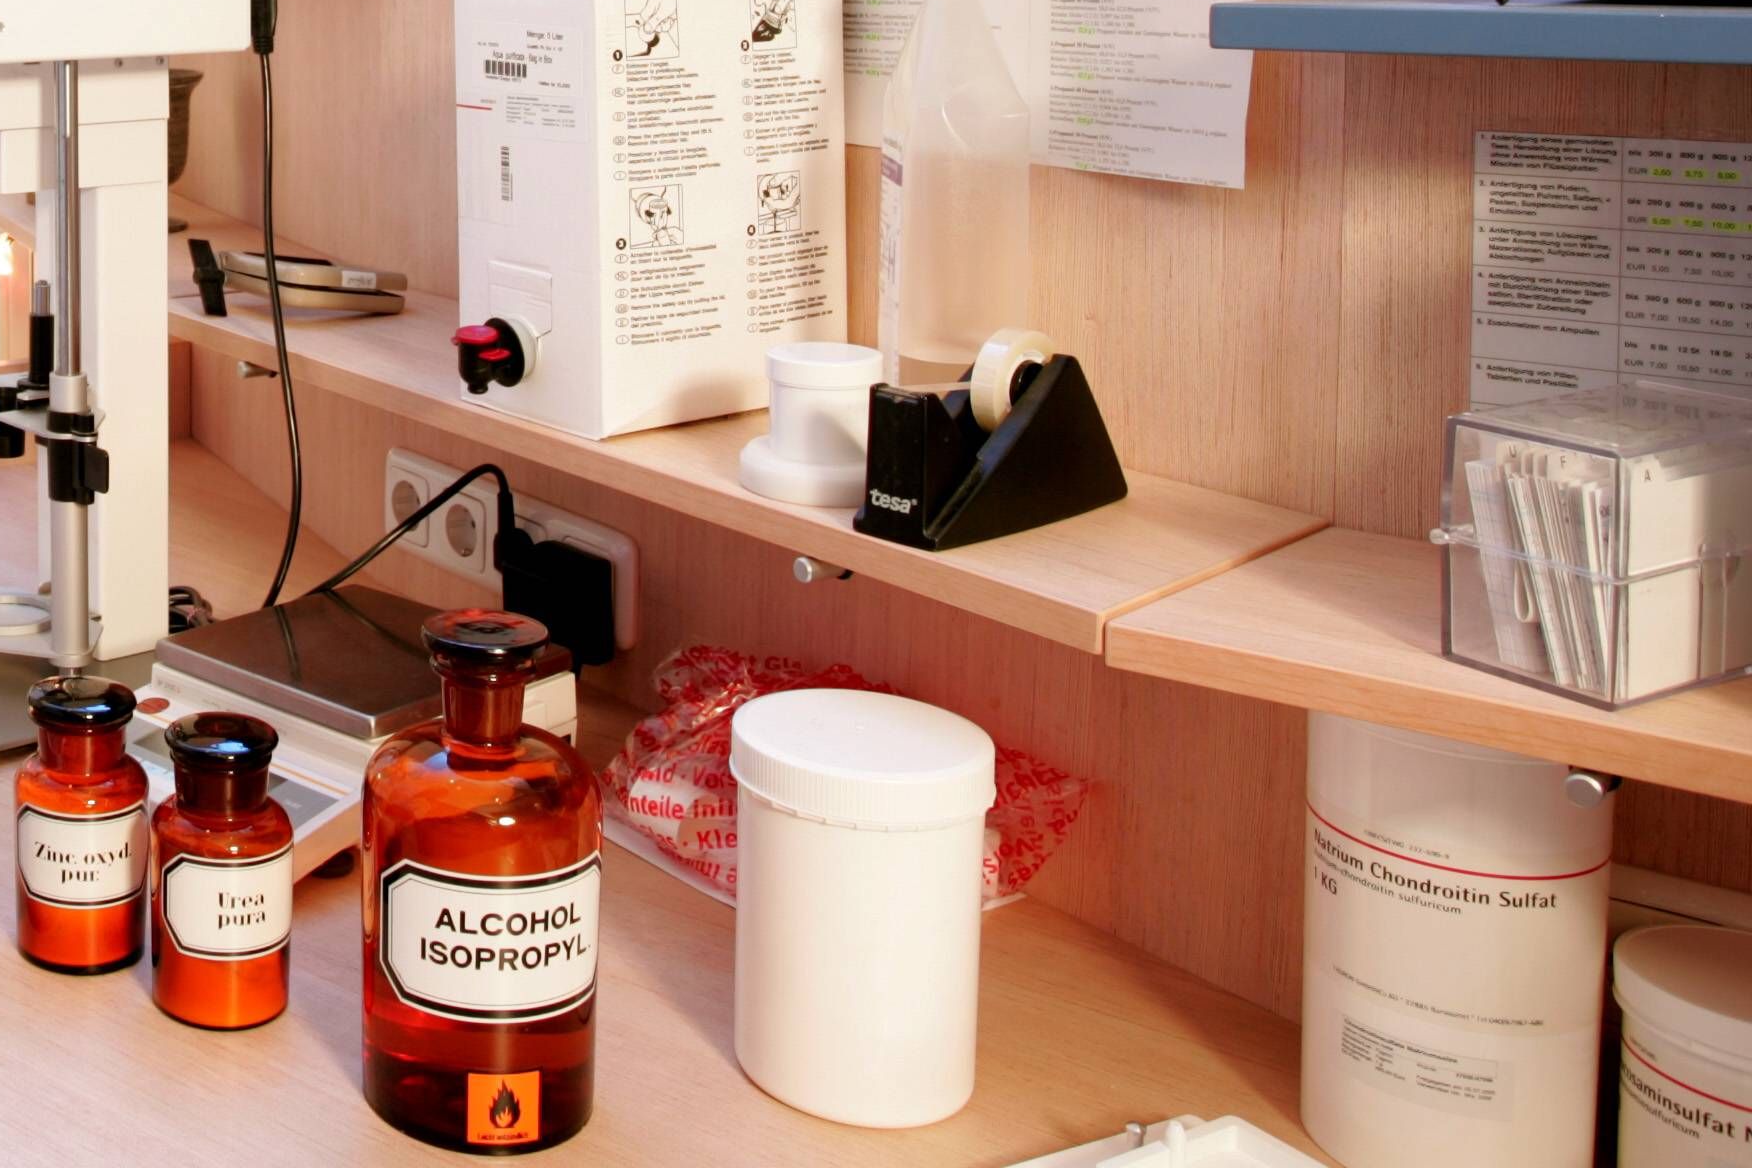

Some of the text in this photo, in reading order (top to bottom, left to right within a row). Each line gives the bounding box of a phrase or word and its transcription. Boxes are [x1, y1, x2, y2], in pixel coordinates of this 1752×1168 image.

[1644, 469, 1651, 481] A
[1314, 828, 1364, 871] Natrium
[1370, 861, 1491, 906] Chondroitin
[1499, 890, 1557, 910] Sulfat
[1321, 871, 1337, 896] KG
[217, 908, 267, 930] pura
[435, 901, 582, 938] ALCOHOL
